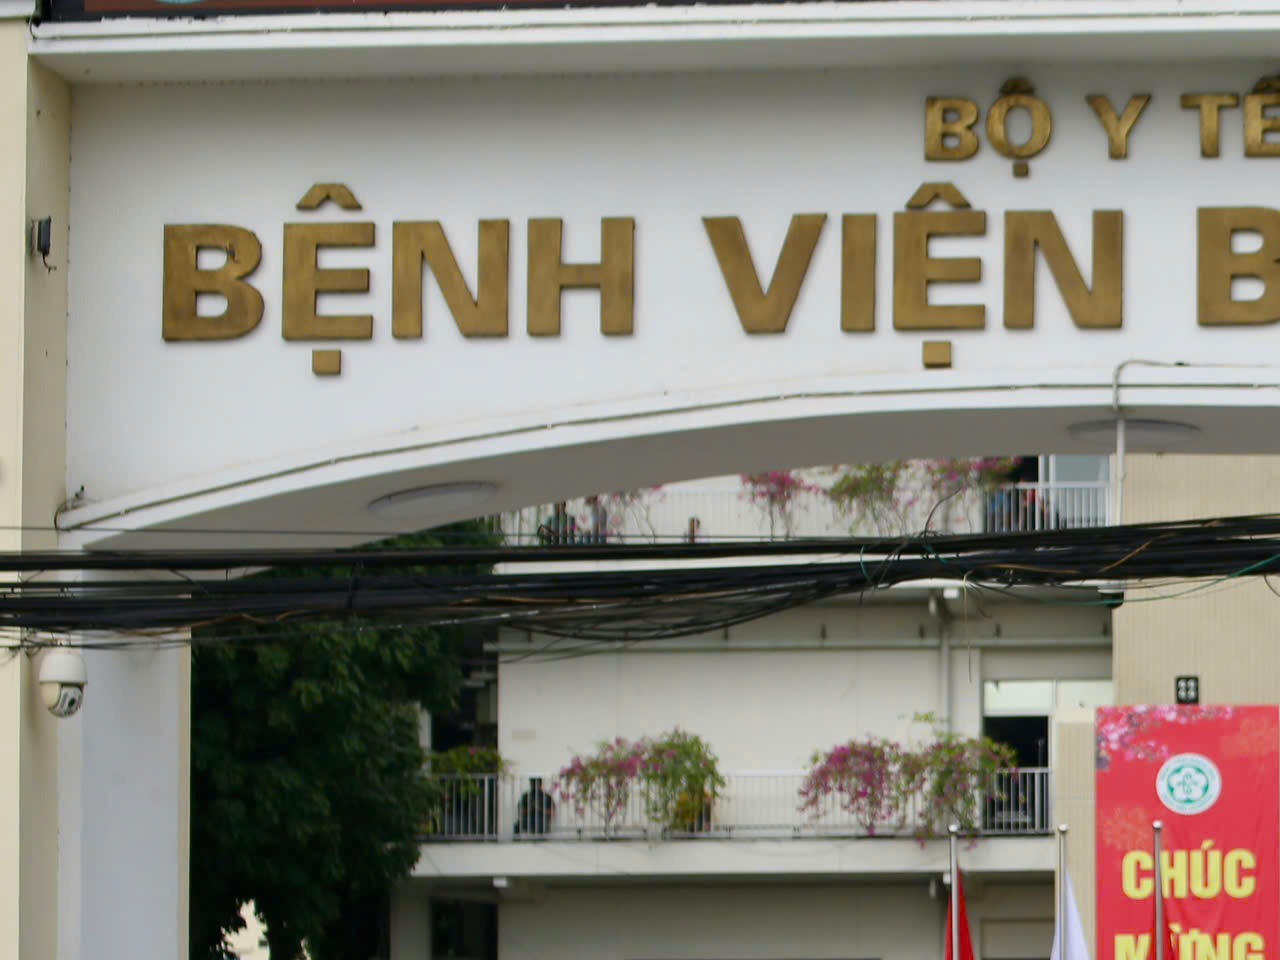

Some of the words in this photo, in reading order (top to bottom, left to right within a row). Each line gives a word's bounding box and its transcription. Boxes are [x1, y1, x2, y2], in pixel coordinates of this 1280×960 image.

[924, 76, 1053, 178] BỘ
[1086, 93, 1152, 159] Y
[162, 183, 636, 375] BỆNH
[703, 182, 1124, 369] VIỆN
[1121, 839, 1256, 900] CHÚC
